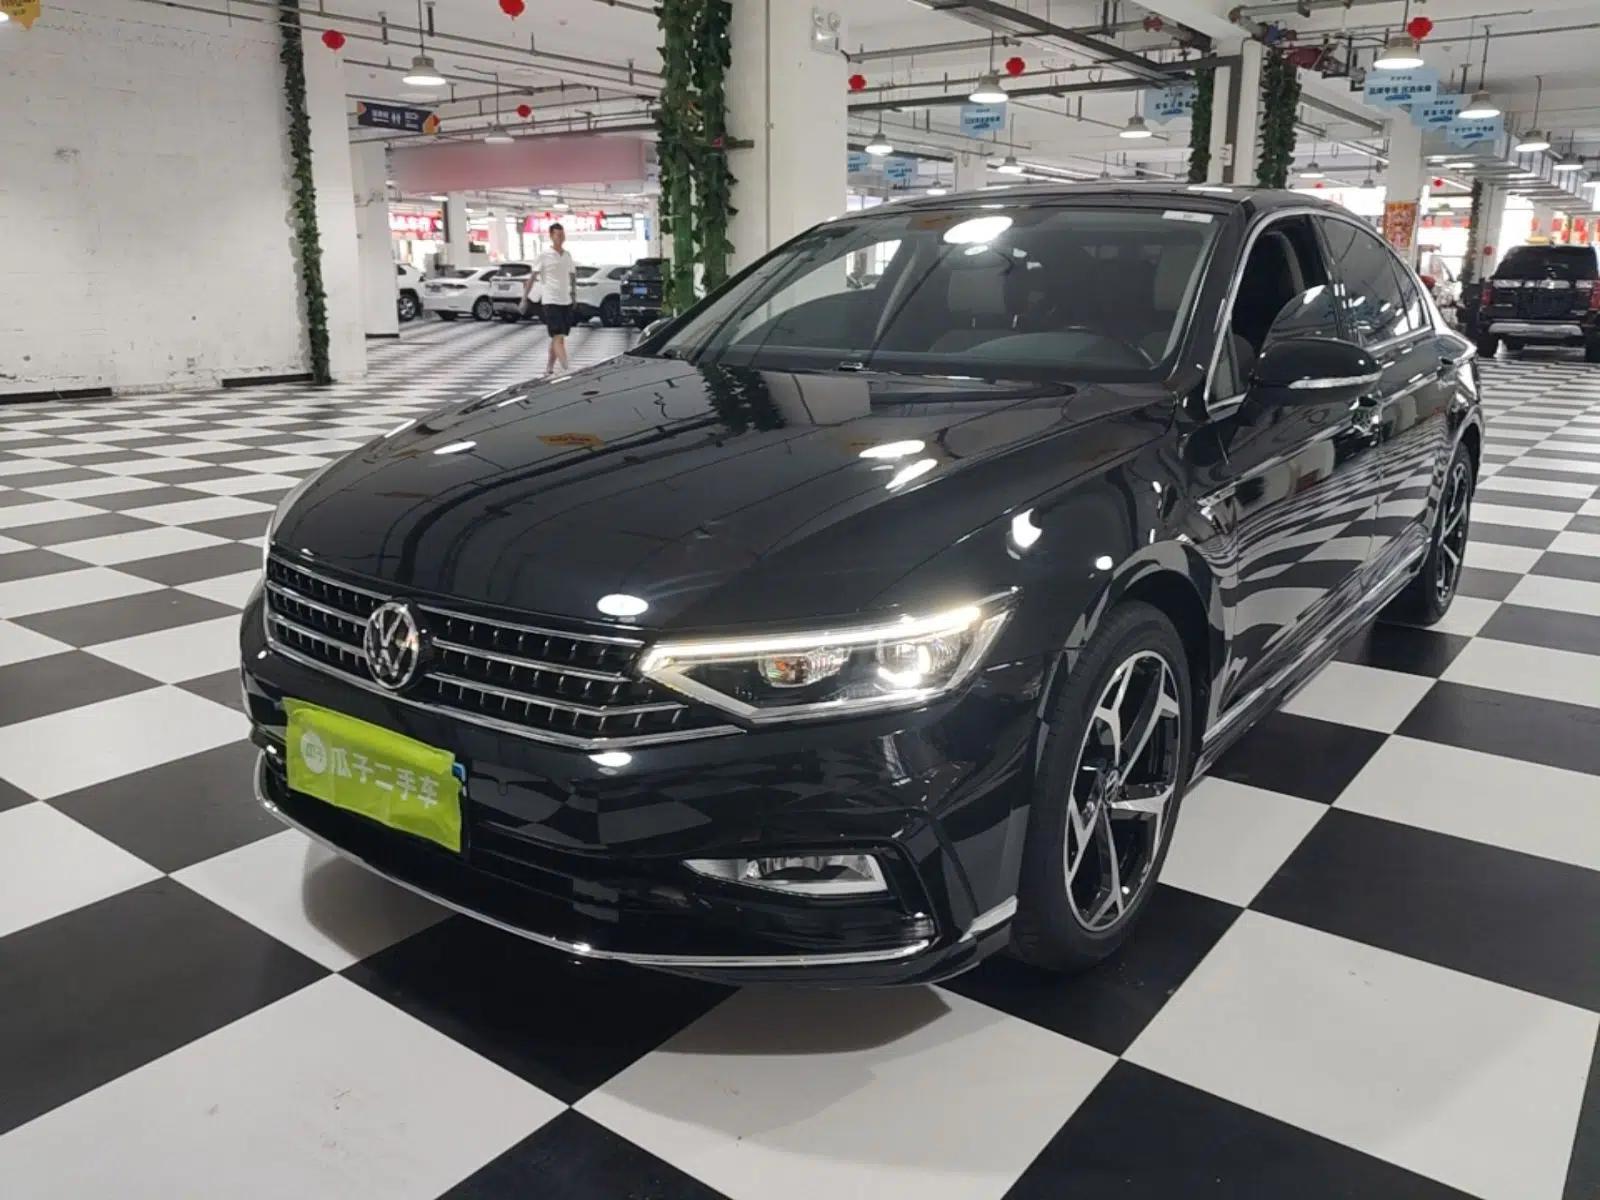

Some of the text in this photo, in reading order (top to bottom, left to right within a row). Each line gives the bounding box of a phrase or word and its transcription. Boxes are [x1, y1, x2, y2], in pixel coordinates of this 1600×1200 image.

[330, 747, 440, 809] 瓜子二手车
